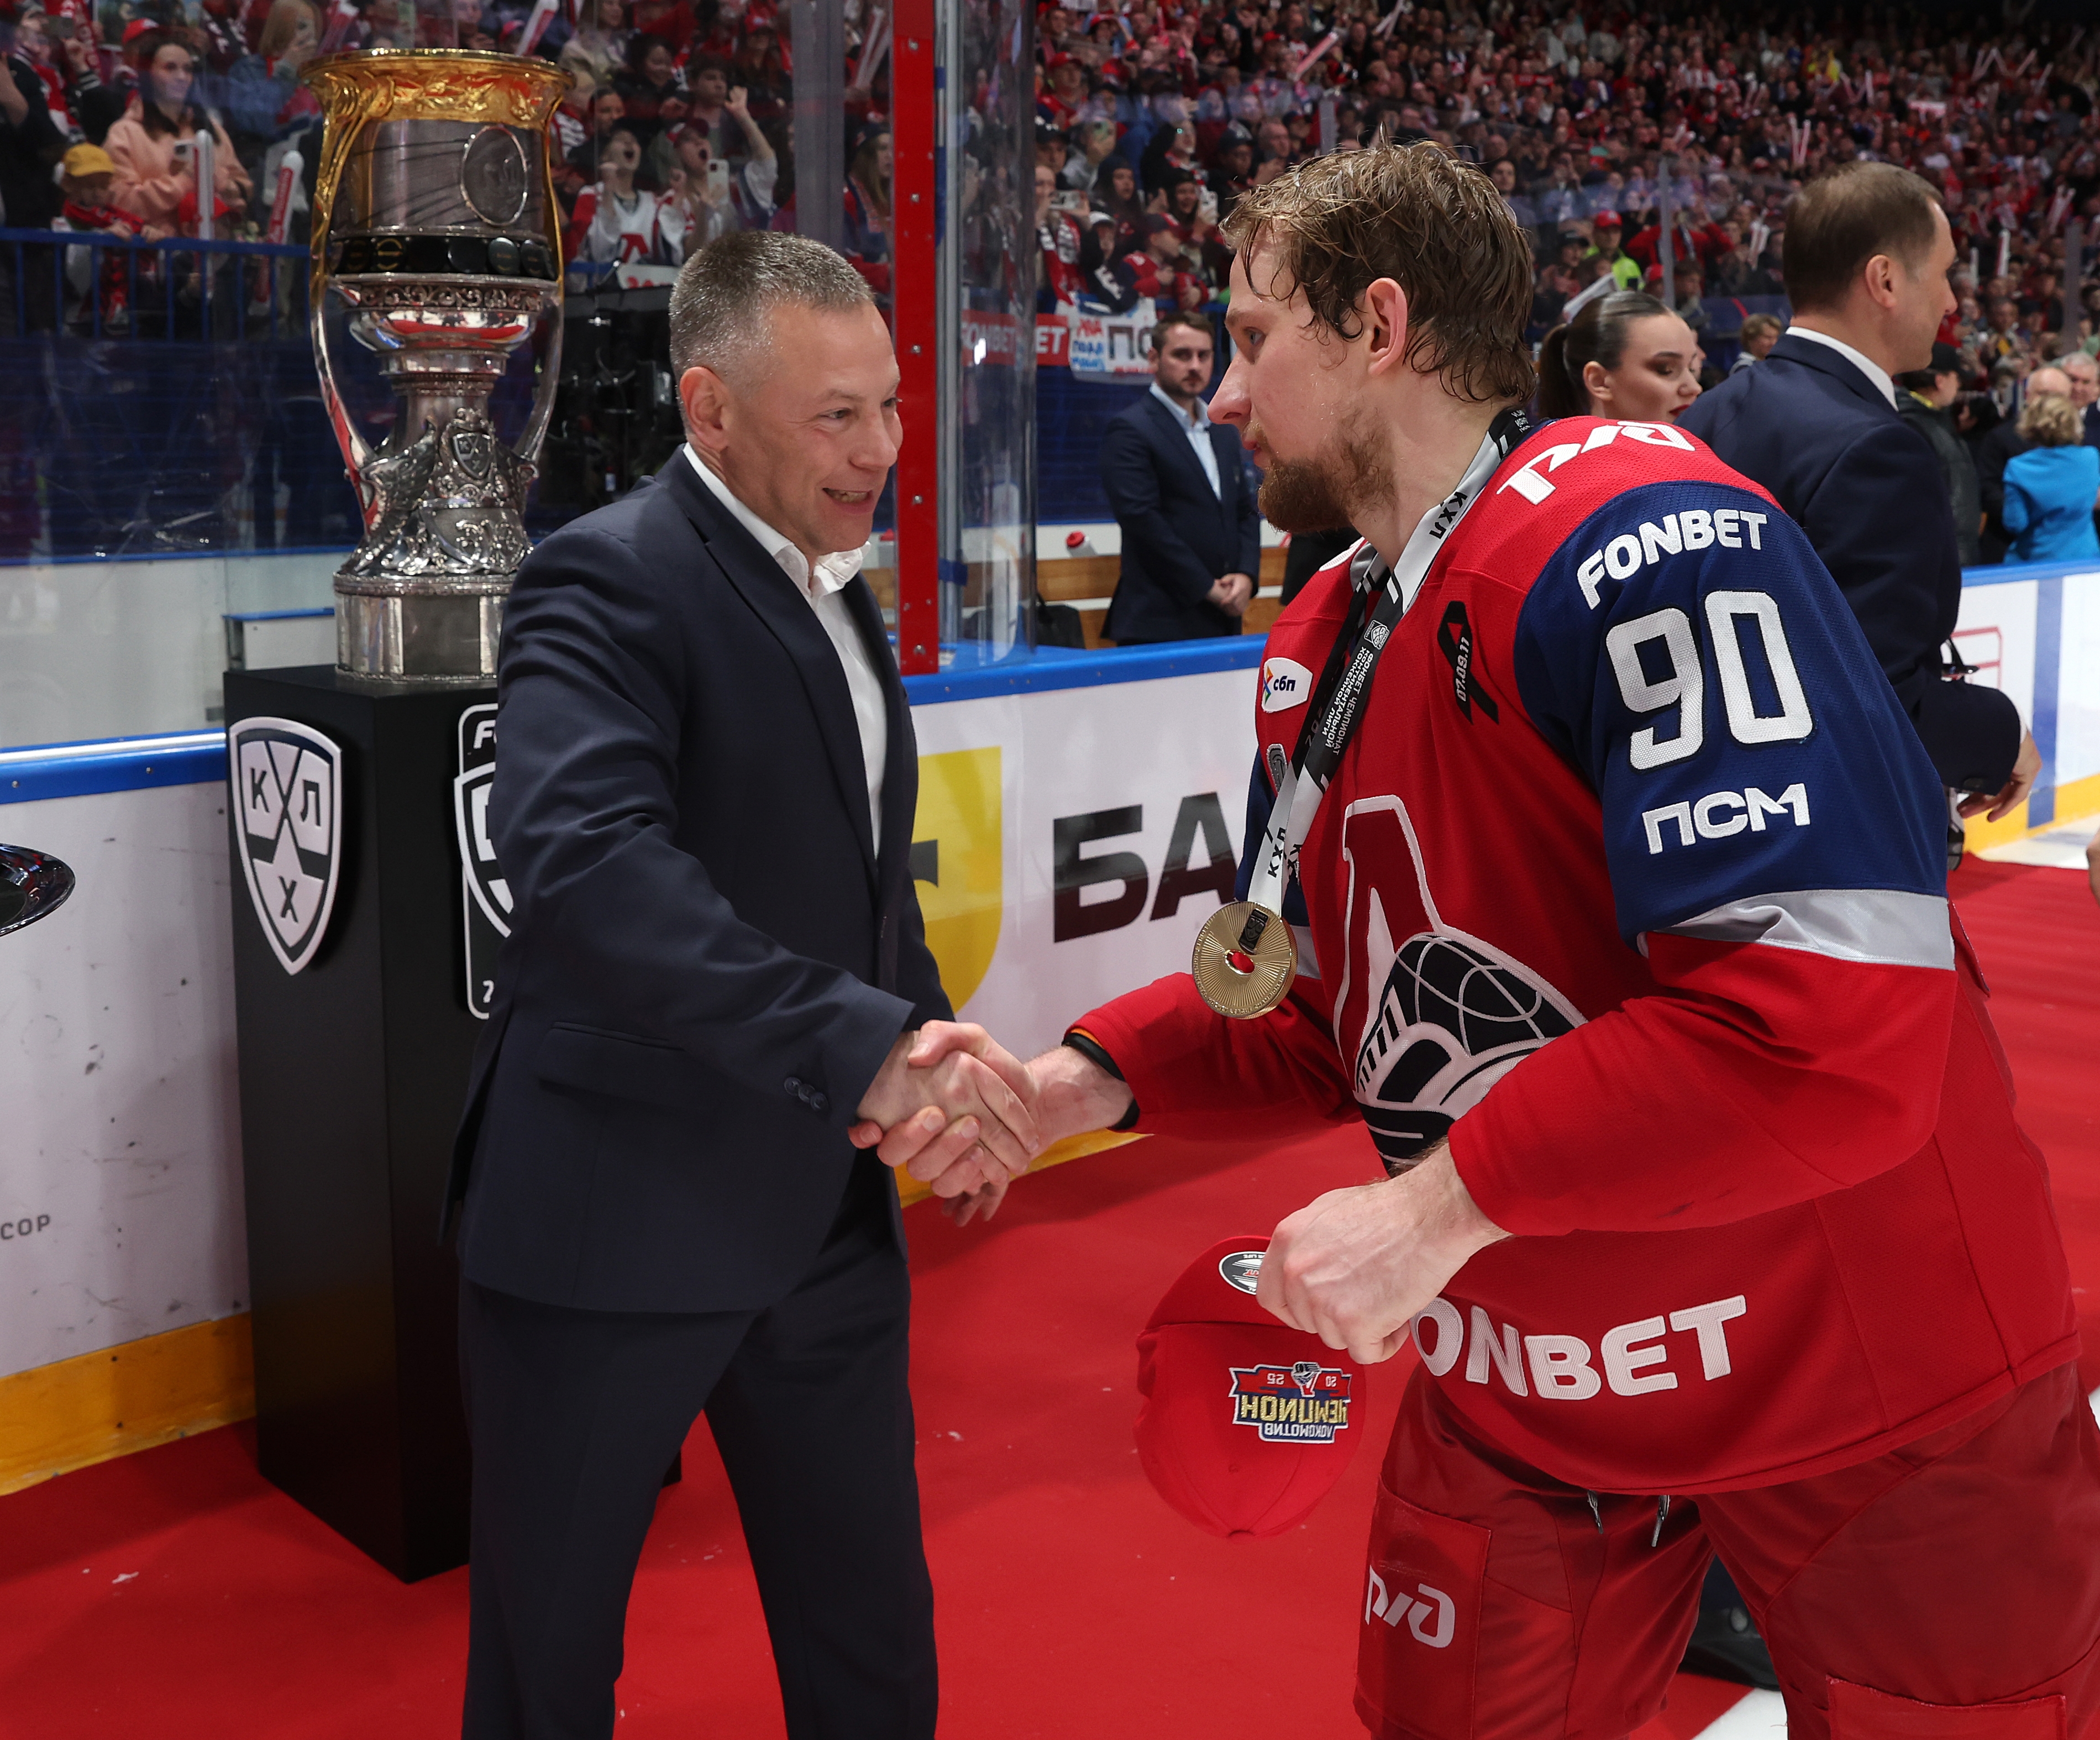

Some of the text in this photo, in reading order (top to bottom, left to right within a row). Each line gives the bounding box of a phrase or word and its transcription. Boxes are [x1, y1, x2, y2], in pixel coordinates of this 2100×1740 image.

[1429, 491, 1468, 539] КХЛ
[1576, 509, 1767, 610] FONBET
[1322, 646, 1367, 735] ХОККЕЙНОЙ ЛИГИ
[1325, 650, 1370, 748] КОНТИНЕНТАЛЬНОЙ
[1332, 653, 1373, 756] ФОНБЕТ ЧЕМПИОНАТ
[1455, 637, 1469, 702] 07.09.11
[1605, 590, 1813, 771] 90
[1642, 783, 1810, 854] ПСМ
[1208, 996, 1229, 1013] HOCKEY
[1230, 1007, 1252, 1015] LEAGUE
[1253, 968, 1287, 1010] CHAMPIONSHIP
[1267, 1373, 1337, 1387] 20 25
[1409, 1294, 1747, 1400] ONBET
[1241, 1395, 1347, 1423] ЧЕМПИОН
[1264, 1423, 1333, 1438] ЛОКОМОТИВ
